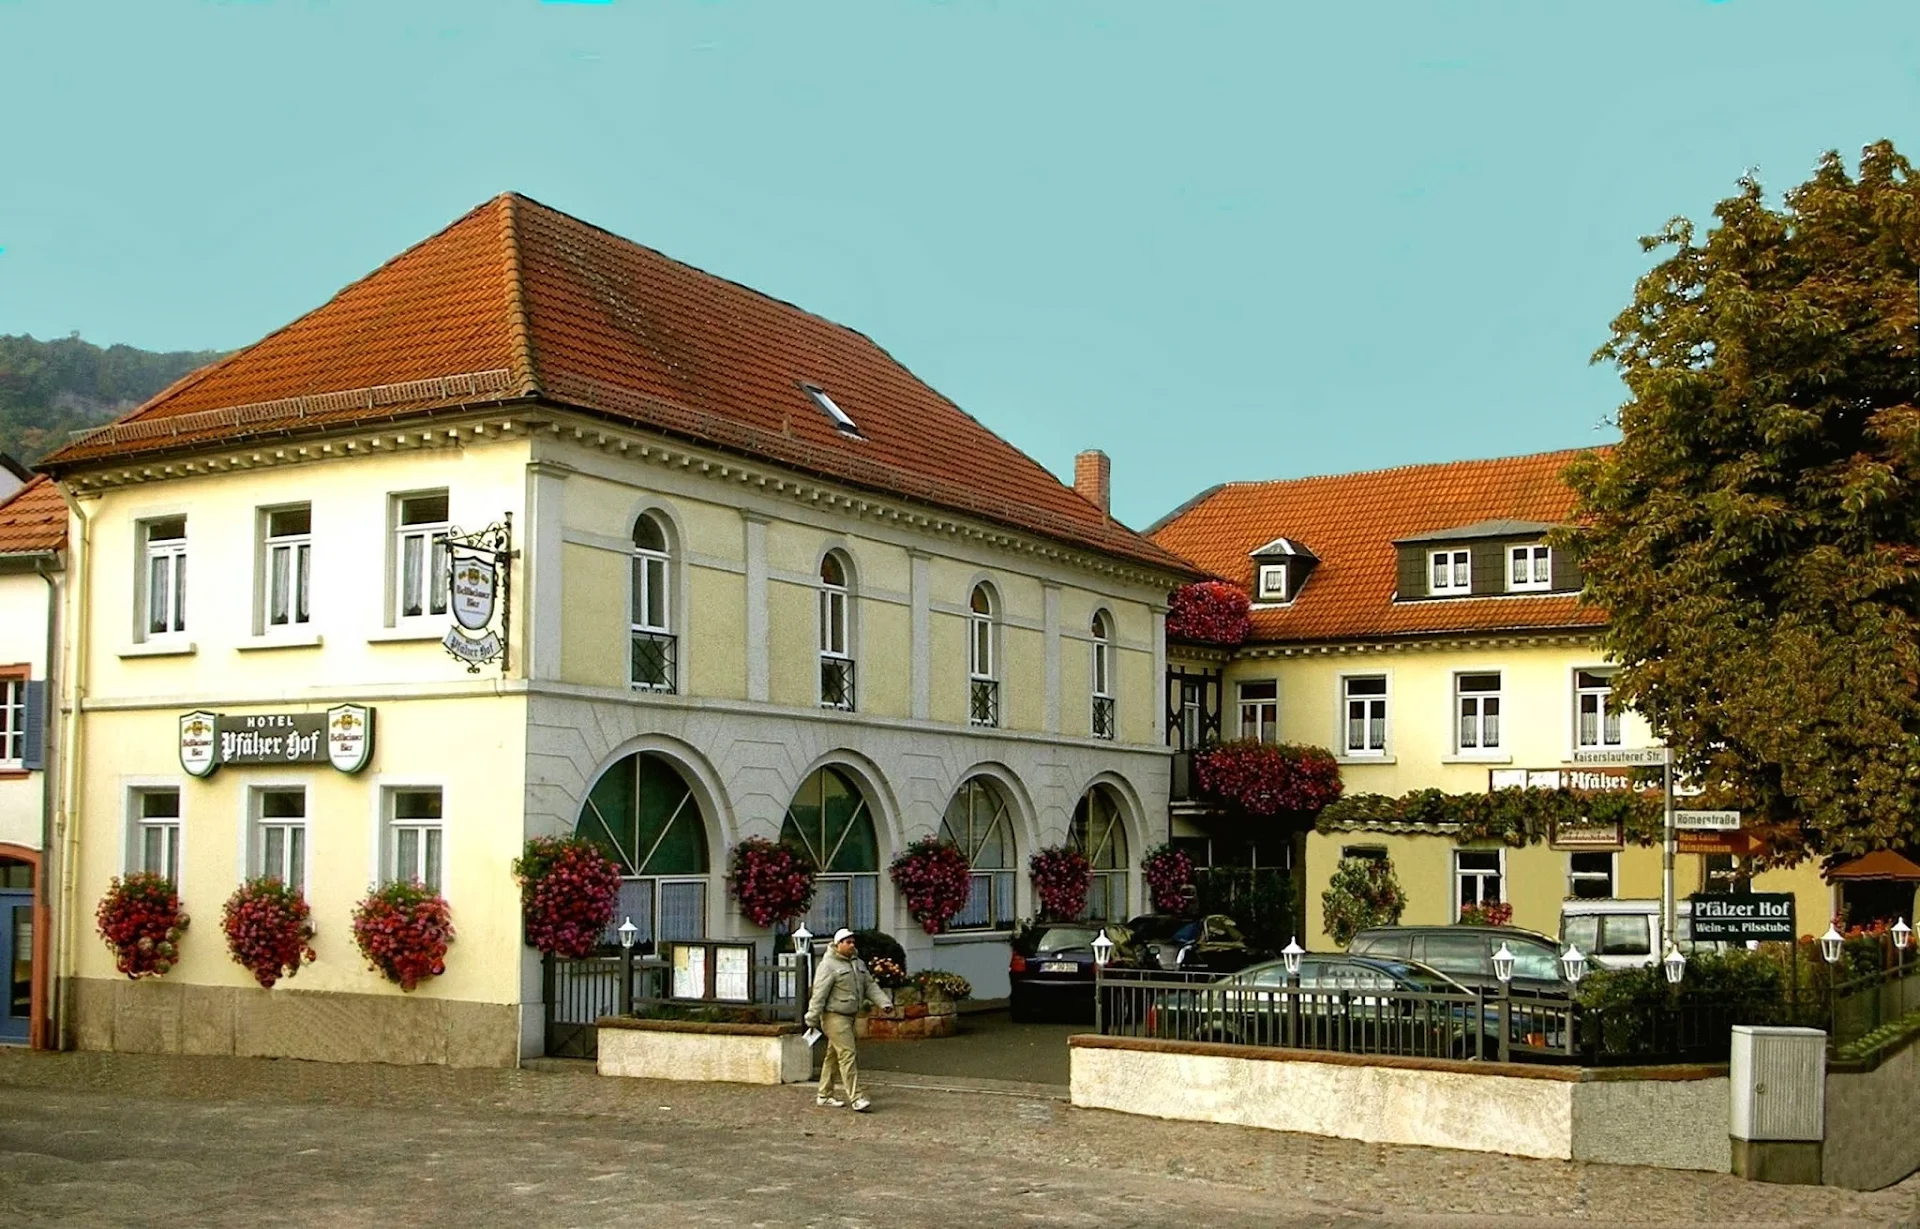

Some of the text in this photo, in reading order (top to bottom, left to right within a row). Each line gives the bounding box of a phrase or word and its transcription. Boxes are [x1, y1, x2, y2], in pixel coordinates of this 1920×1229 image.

[246, 715, 295, 728] HOTEL
[221, 730, 321, 763] Pfälzer Hof
[1573, 751, 1663, 763] Kaiserslauterer Str.
[1677, 813, 1737, 825] Römerstraße
[1695, 901, 1790, 916] Pfälzer Hof
[1695, 922, 1791, 933] Wein- u. Pilsstube
